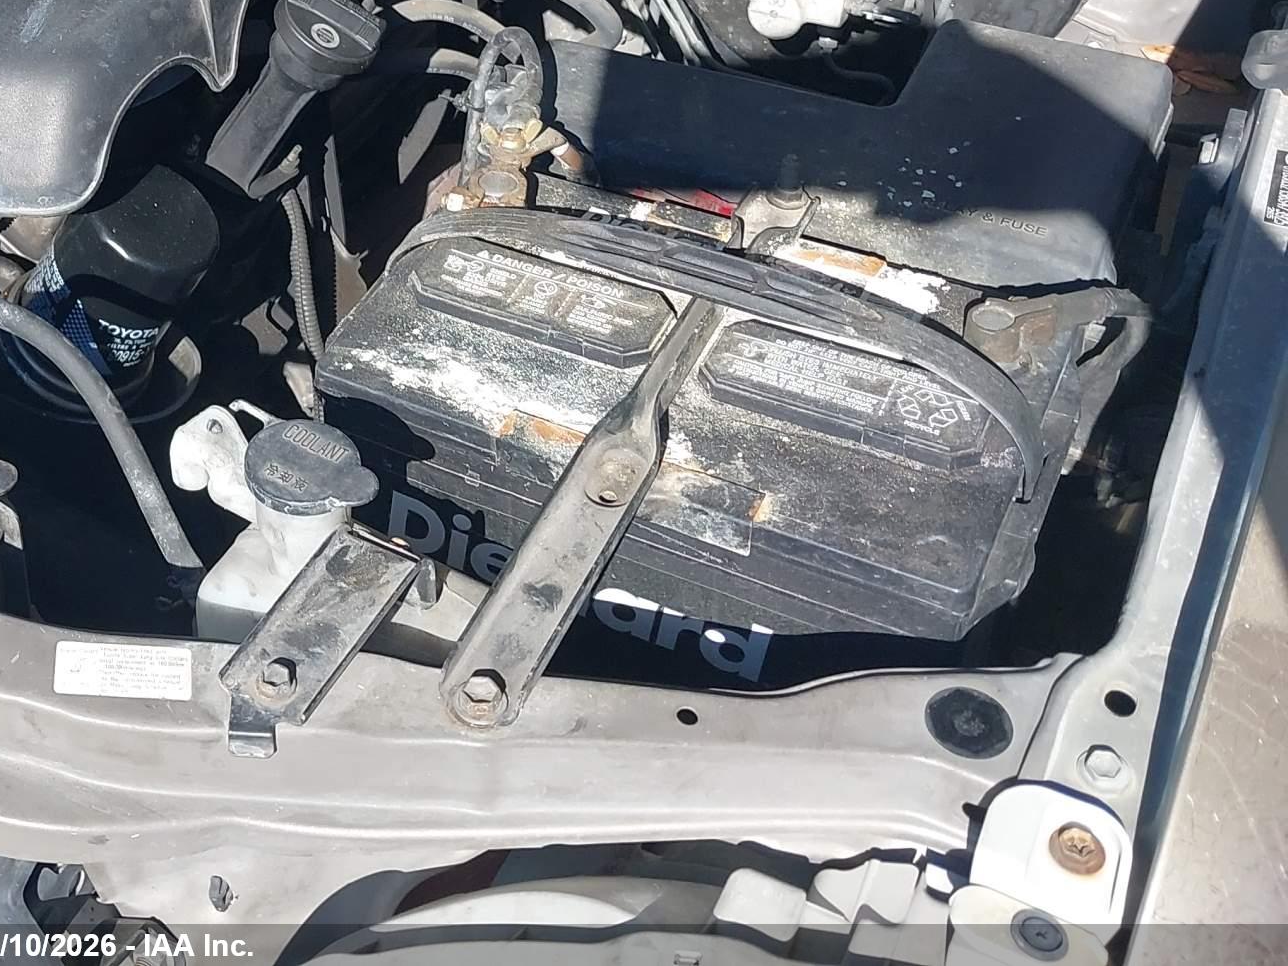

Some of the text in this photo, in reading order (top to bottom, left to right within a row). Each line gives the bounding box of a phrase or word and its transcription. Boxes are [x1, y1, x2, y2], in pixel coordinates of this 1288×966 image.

[982, 212, 993, 222] &
[1000, 217, 1048, 237] FUSE
[491, 254, 553, 277] DANGER
[566, 275, 624, 298] POISON
[98, 318, 159, 339] TOYOTA
[763, 357, 798, 372] MEDICAL
[800, 367, 824, 379] HELP
[821, 360, 878, 382] IMMEDIATELY
[903, 419, 940, 436] RECYCLE
[283, 424, 350, 463] COOLANT
[387, 489, 774, 683] Dieard
